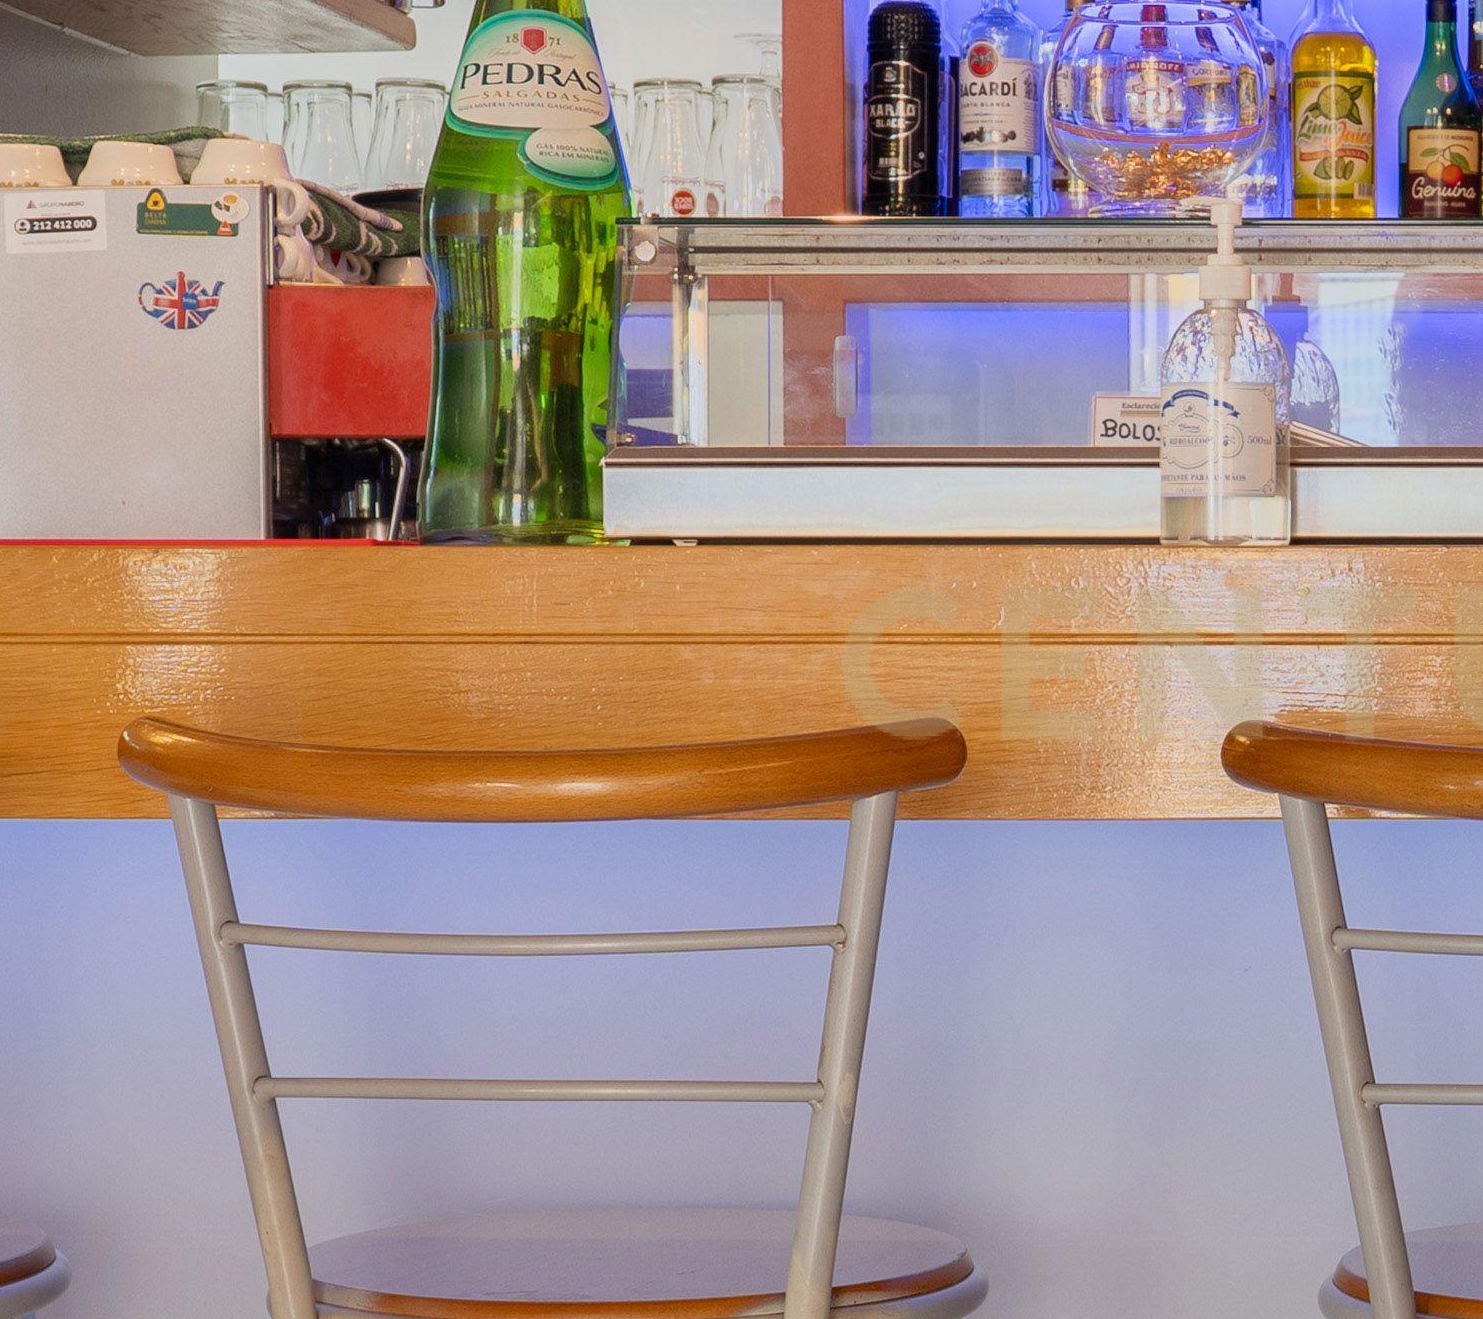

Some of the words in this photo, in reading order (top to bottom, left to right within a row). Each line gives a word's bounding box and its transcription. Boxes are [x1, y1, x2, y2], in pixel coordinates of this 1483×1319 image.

[506, 35, 519, 44] 18
[549, 37, 561, 46] 71
[460, 62, 602, 95] PEDRAS
[960, 78, 1018, 97] ACARDÍ
[483, 90, 580, 102] SALGADAS
[33, 221, 52, 230] 212
[53, 220, 73, 230] 412
[74, 219, 92, 229] 000
